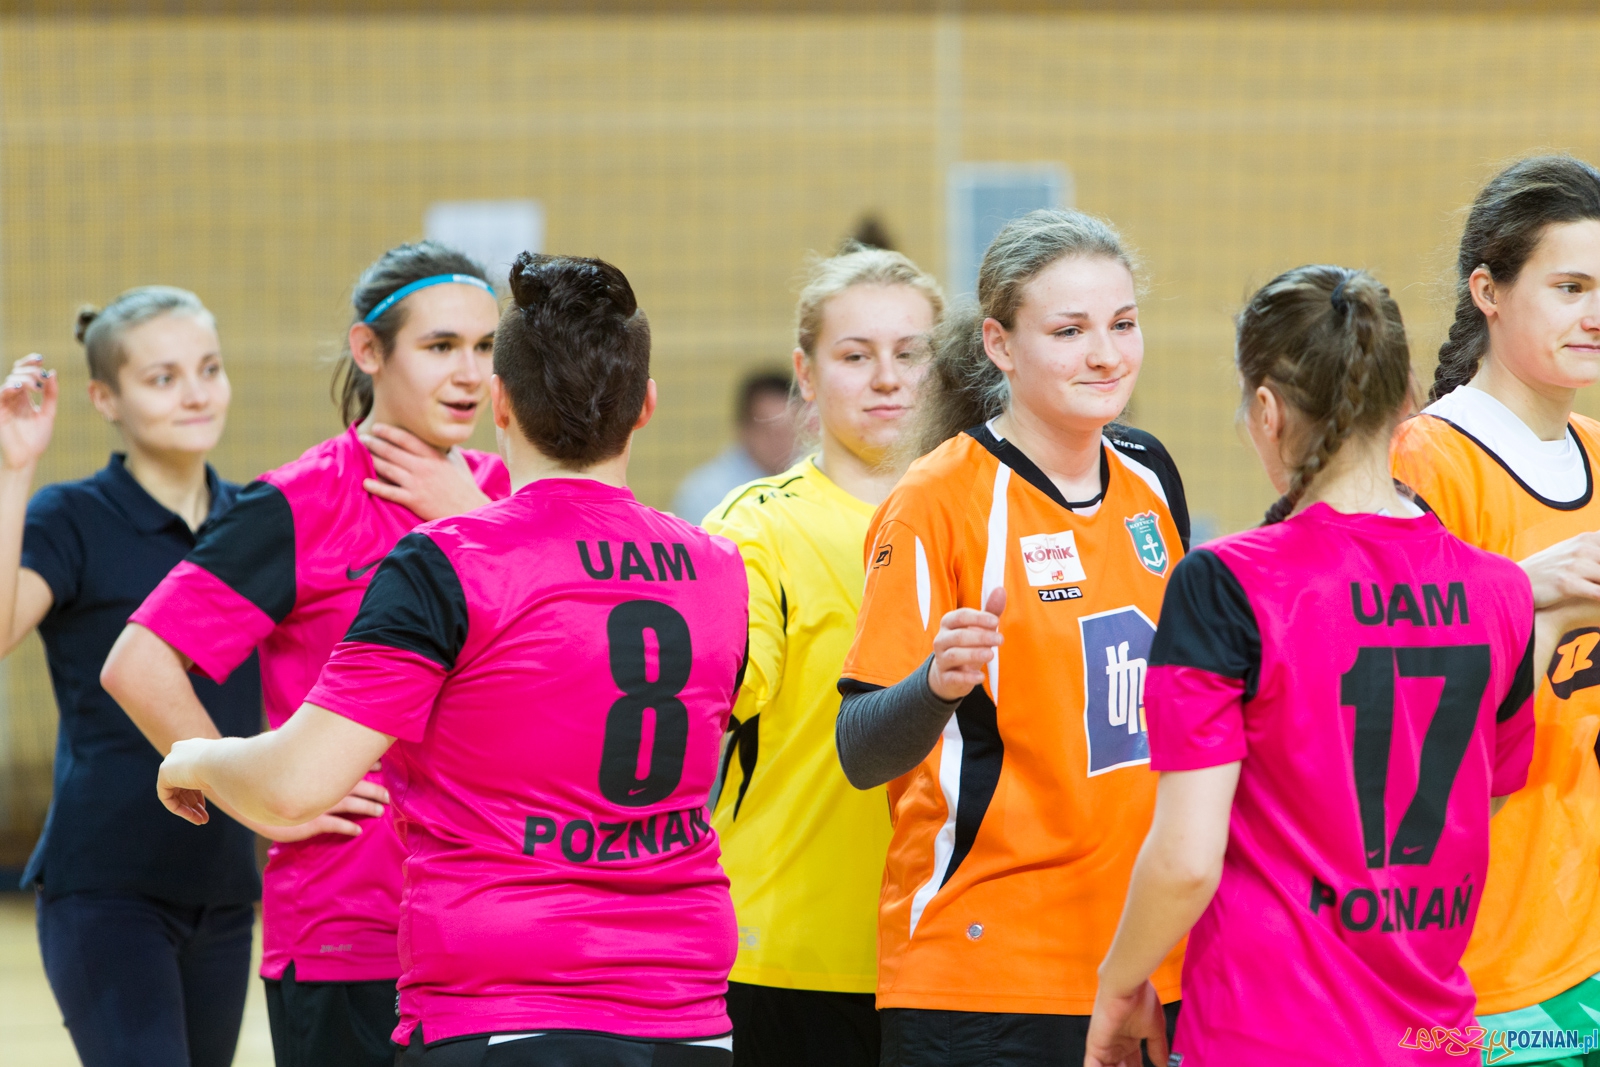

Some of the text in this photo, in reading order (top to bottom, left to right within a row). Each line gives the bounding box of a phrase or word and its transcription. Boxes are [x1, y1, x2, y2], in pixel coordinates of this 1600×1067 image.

[575, 540, 697, 581] UAM
[1350, 581, 1470, 627] UAM
[598, 599, 692, 807] 8
[1340, 643, 1491, 869] 17
